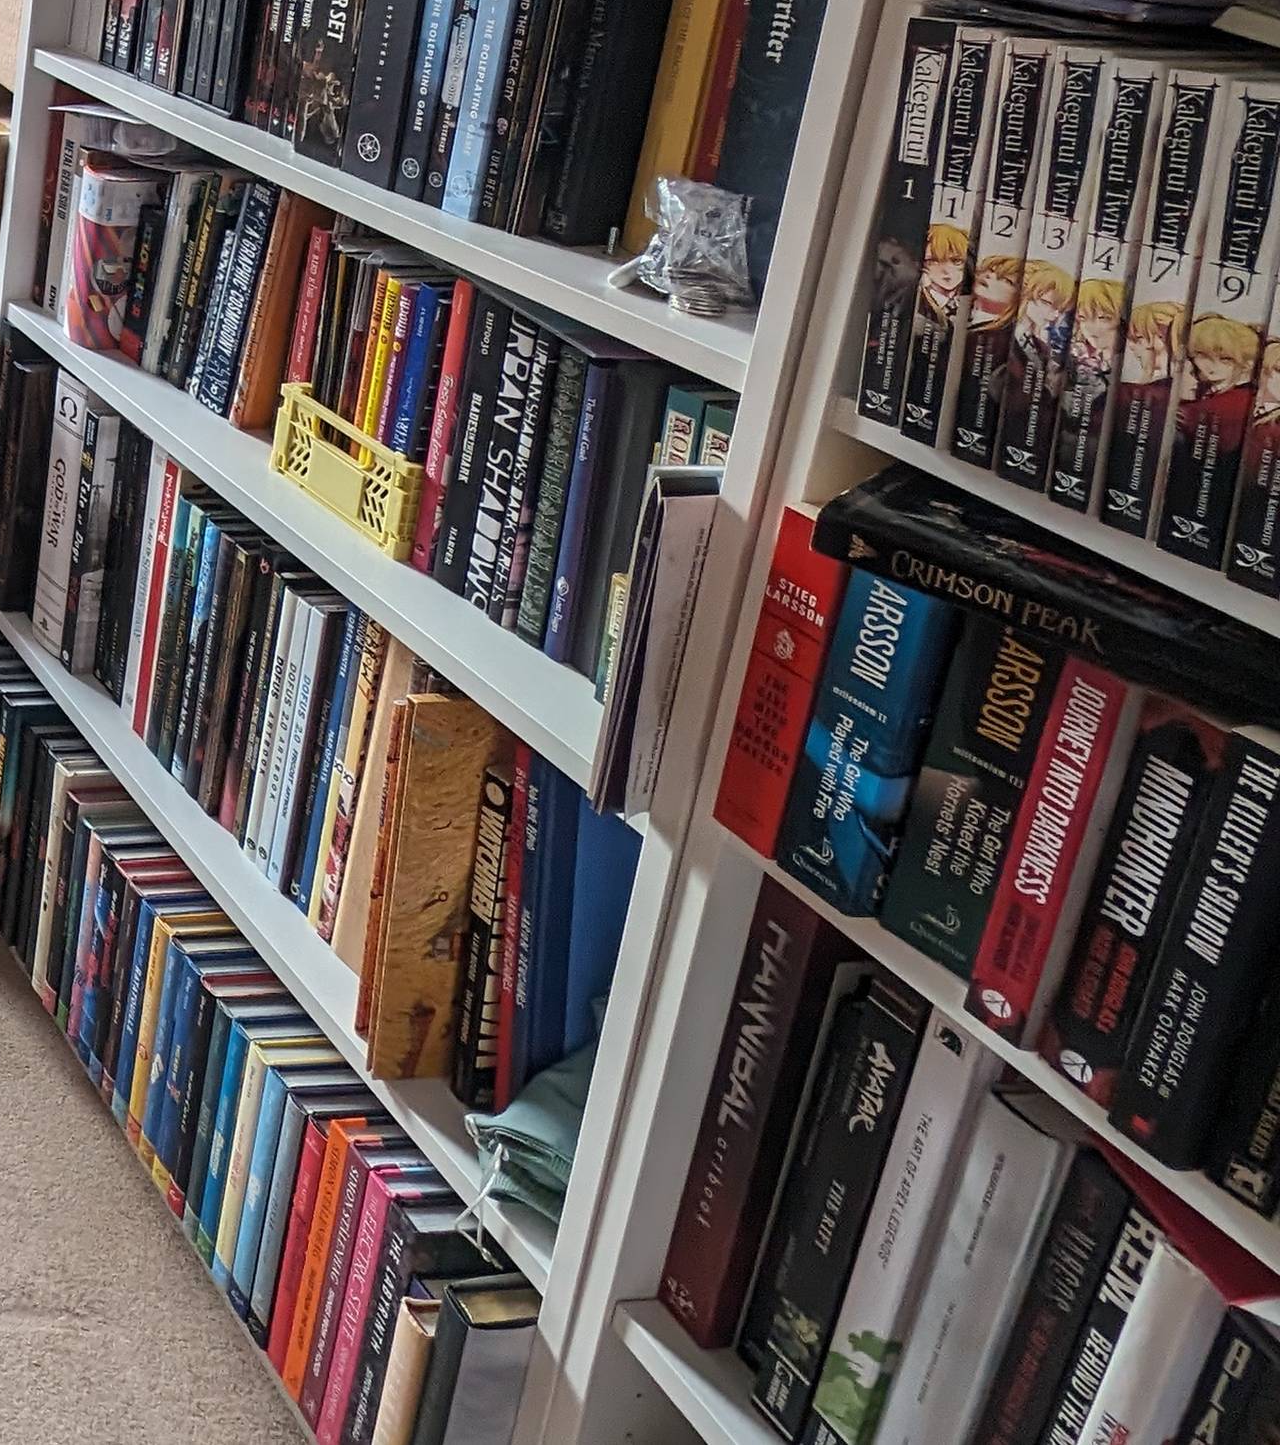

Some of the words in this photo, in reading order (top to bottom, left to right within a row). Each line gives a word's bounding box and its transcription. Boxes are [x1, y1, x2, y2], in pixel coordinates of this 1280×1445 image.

[326, 10, 345, 44] SET
[482, 18, 495, 39] THE
[514, 13, 527, 35] THE
[418, 22, 438, 95] ROLEPLAYING
[506, 38, 523, 74] BLACK
[468, 44, 490, 119] ROLEPLAYING
[950, 42, 987, 141] Kakegurui
[413, 100, 425, 131] GAME
[905, 49, 942, 165] Kakegurui
[1002, 57, 1039, 160] Kakegurui
[1054, 65, 1093, 166] Kakegurui
[1105, 81, 1145, 184] Kakegurui
[1163, 87, 1207, 195] Kakegurui
[62, 139, 74, 167] METAL
[488, 149, 502, 175] LUKA
[946, 141, 970, 190] Twin
[1237, 100, 1278, 209] Kakegurui
[60, 169, 71, 193] GEAR
[902, 178, 915, 201] 1
[998, 159, 1024, 208] Twin
[1047, 168, 1077, 218] Twin
[56, 194, 68, 220] SOLID
[946, 197, 958, 221] 1
[994, 214, 1014, 238] 2
[1103, 185, 1131, 240] Twin
[1160, 196, 1190, 252] Twin
[1045, 227, 1065, 250] 3
[1232, 209, 1263, 268] Twin
[232, 239, 256, 288] GRAPHIC
[1093, 247, 1115, 271] 4
[1151, 256, 1176, 284] 7
[47, 284, 57, 310] IDW
[1223, 275, 1245, 304] 9
[216, 289, 244, 356] COSMOGONY
[527, 339, 548, 402] URBAN
[466, 393, 482, 432] BLADES
[583, 412, 593, 432] Book
[586, 397, 595, 412] The
[48, 457, 69, 499] GOD
[457, 452, 472, 482] DARK
[76, 477, 91, 509] Isle
[44, 508, 63, 547] WAR
[69, 530, 84, 564] Dogs
[443, 526, 458, 565] HARPER
[765, 586, 825, 628] LARSSON
[777, 576, 818, 608] STIEG
[890, 551, 1014, 615] CRIMSON
[1021, 601, 1107, 654] PEAK
[344, 611, 356, 644] ROBERT
[268, 655, 285, 699] DOFUS
[338, 644, 350, 678] HUNTER
[282, 662, 298, 706] DOFUS
[295, 674, 312, 720] DOFUS
[278, 710, 290, 731] 2.0
[292, 722, 303, 744] 2.0
[326, 729, 335, 748] MAP
[824, 711, 853, 763] Played
[1052, 676, 1107, 769] JOURNEY
[256, 711, 276, 776] ARTBOOK
[324, 748, 331, 759] OF
[849, 735, 868, 762] The
[266, 735, 286, 802] ARTBOOK
[319, 759, 329, 783] DAYS
[820, 762, 839, 792] with
[841, 761, 861, 789] Girl
[1040, 758, 1082, 811] INTO
[1237, 754, 1280, 800] THE
[812, 791, 832, 820] Fire
[832, 789, 854, 822] Who
[933, 773, 967, 841] Hornets'
[955, 798, 987, 850] Kicked
[987, 805, 1010, 835] The
[923, 838, 948, 876] Nest
[977, 832, 1003, 863] Girl
[1013, 800, 1070, 904] DARKNESS
[1099, 754, 1193, 938] MINDHUNTER
[1210, 792, 1268, 883] KILLER'S
[471, 805, 506, 927] WATCHMEN
[949, 849, 969, 877] the
[968, 861, 993, 896] Who
[1185, 875, 1241, 965] SHADOW
[125, 965, 141, 1034] RATATOUILLE
[1163, 968, 1187, 1010] MARK
[1183, 980, 1208, 1020] JOHN
[710, 917, 801, 1135] HANNIBAL
[1138, 1013, 1174, 1087] OLSHAKER
[1162, 1021, 1195, 1085] DOUGLAS
[845, 1040, 901, 1139] AVATAR
[916, 1112, 932, 1136] THE
[326, 1145, 339, 1183] SIMON
[908, 1135, 926, 1162] ART
[343, 1166, 359, 1210] SIMON
[904, 1162, 918, 1178] OF
[825, 1179, 845, 1212] THE
[894, 1177, 913, 1208] APEX
[349, 1211, 378, 1292] ELECTRIC
[387, 1231, 403, 1262] THE
[813, 1213, 836, 1254] RIFT
[339, 1289, 362, 1344] STATE
[367, 1265, 397, 1354] LABYRINTH
[1066, 1327, 1117, 1397] BEHIND
[1053, 1390, 1090, 1435] THE
